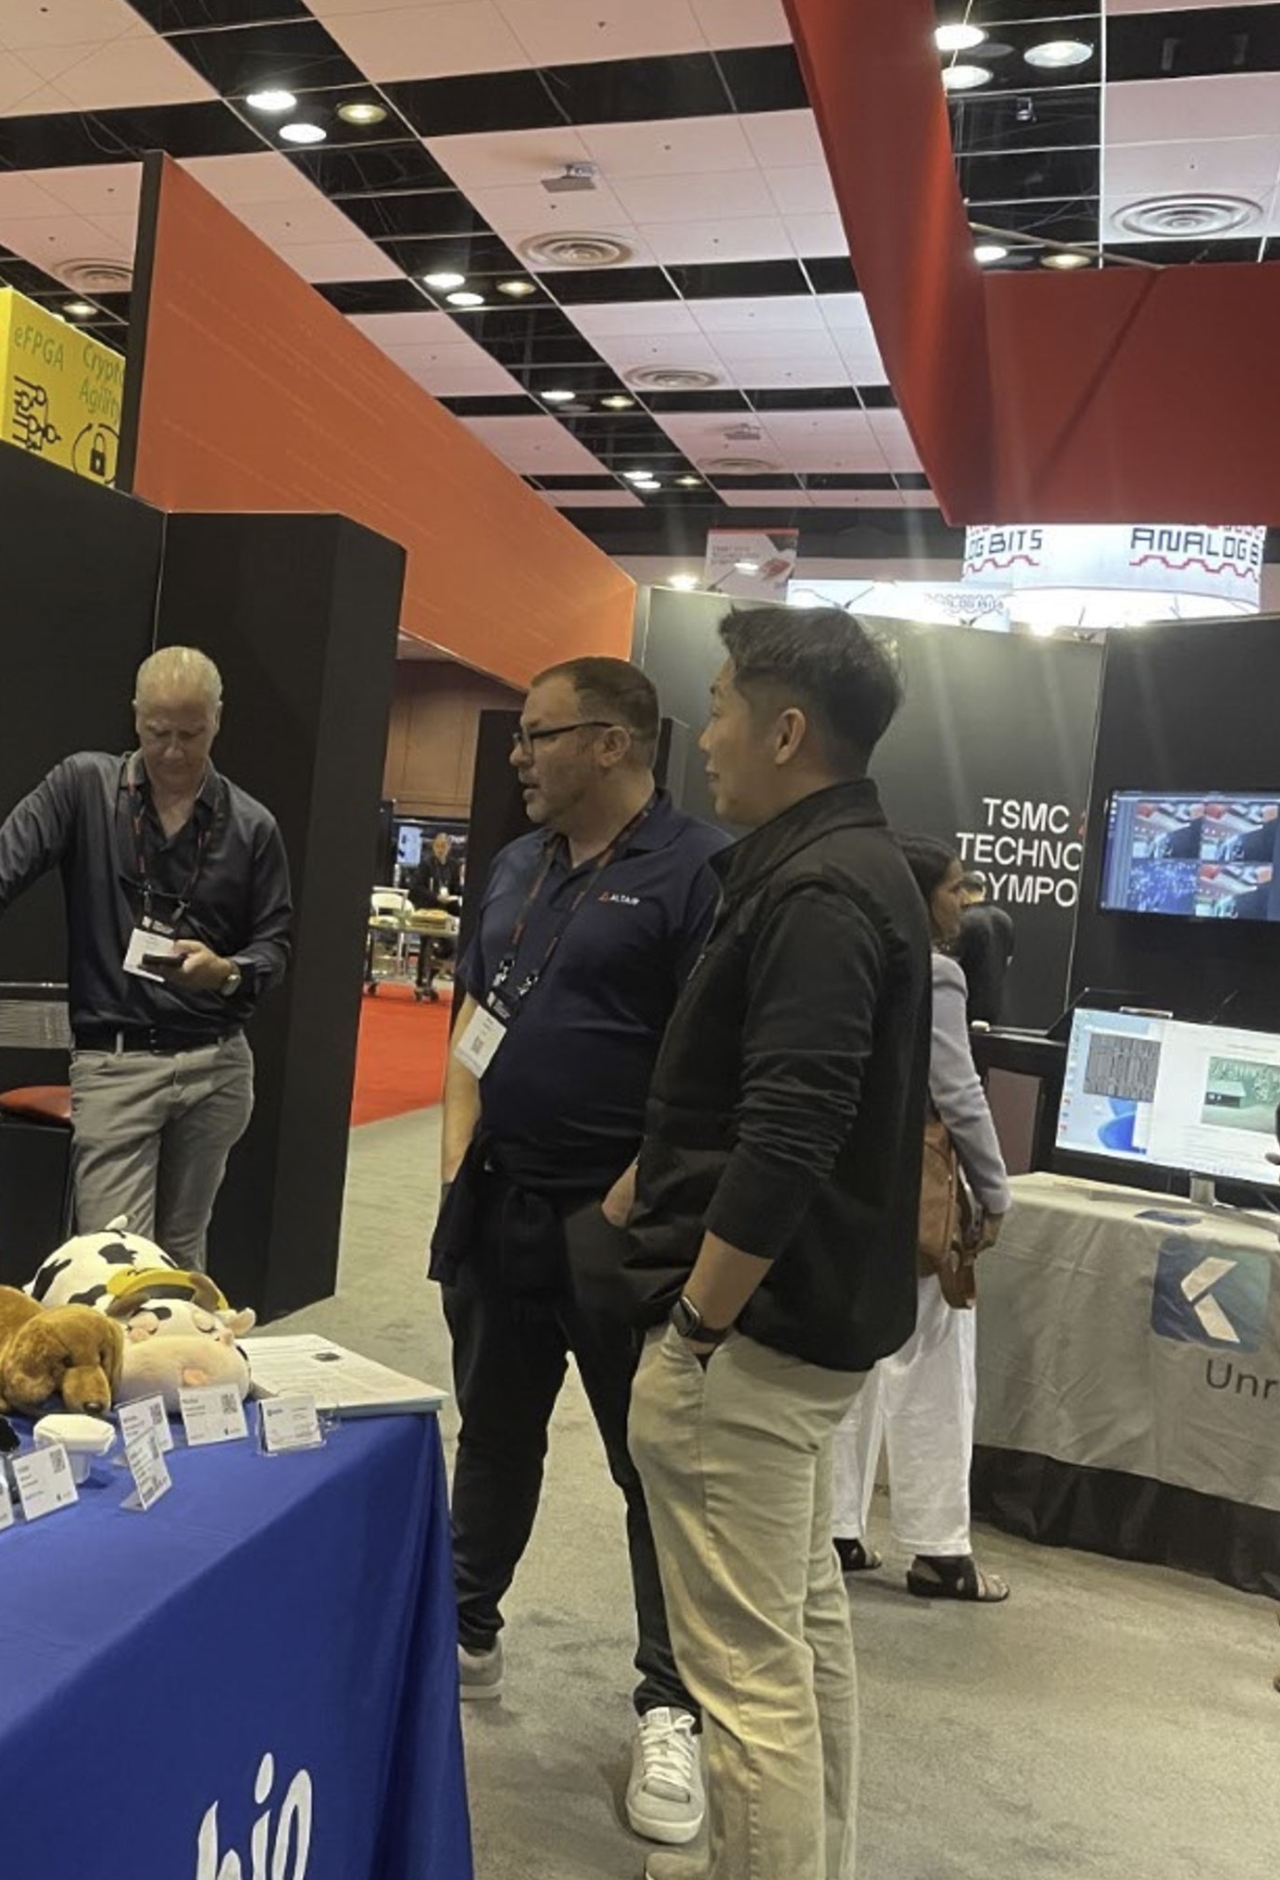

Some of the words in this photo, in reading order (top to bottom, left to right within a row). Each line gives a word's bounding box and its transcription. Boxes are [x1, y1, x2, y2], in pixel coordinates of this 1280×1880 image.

[14, 324, 65, 372] eFPGA
[989, 529, 1043, 554] BITS
[1130, 527, 1246, 561] ANALOG
[983, 797, 1070, 834] TSMC
[1206, 1358, 1278, 1399] Unr
